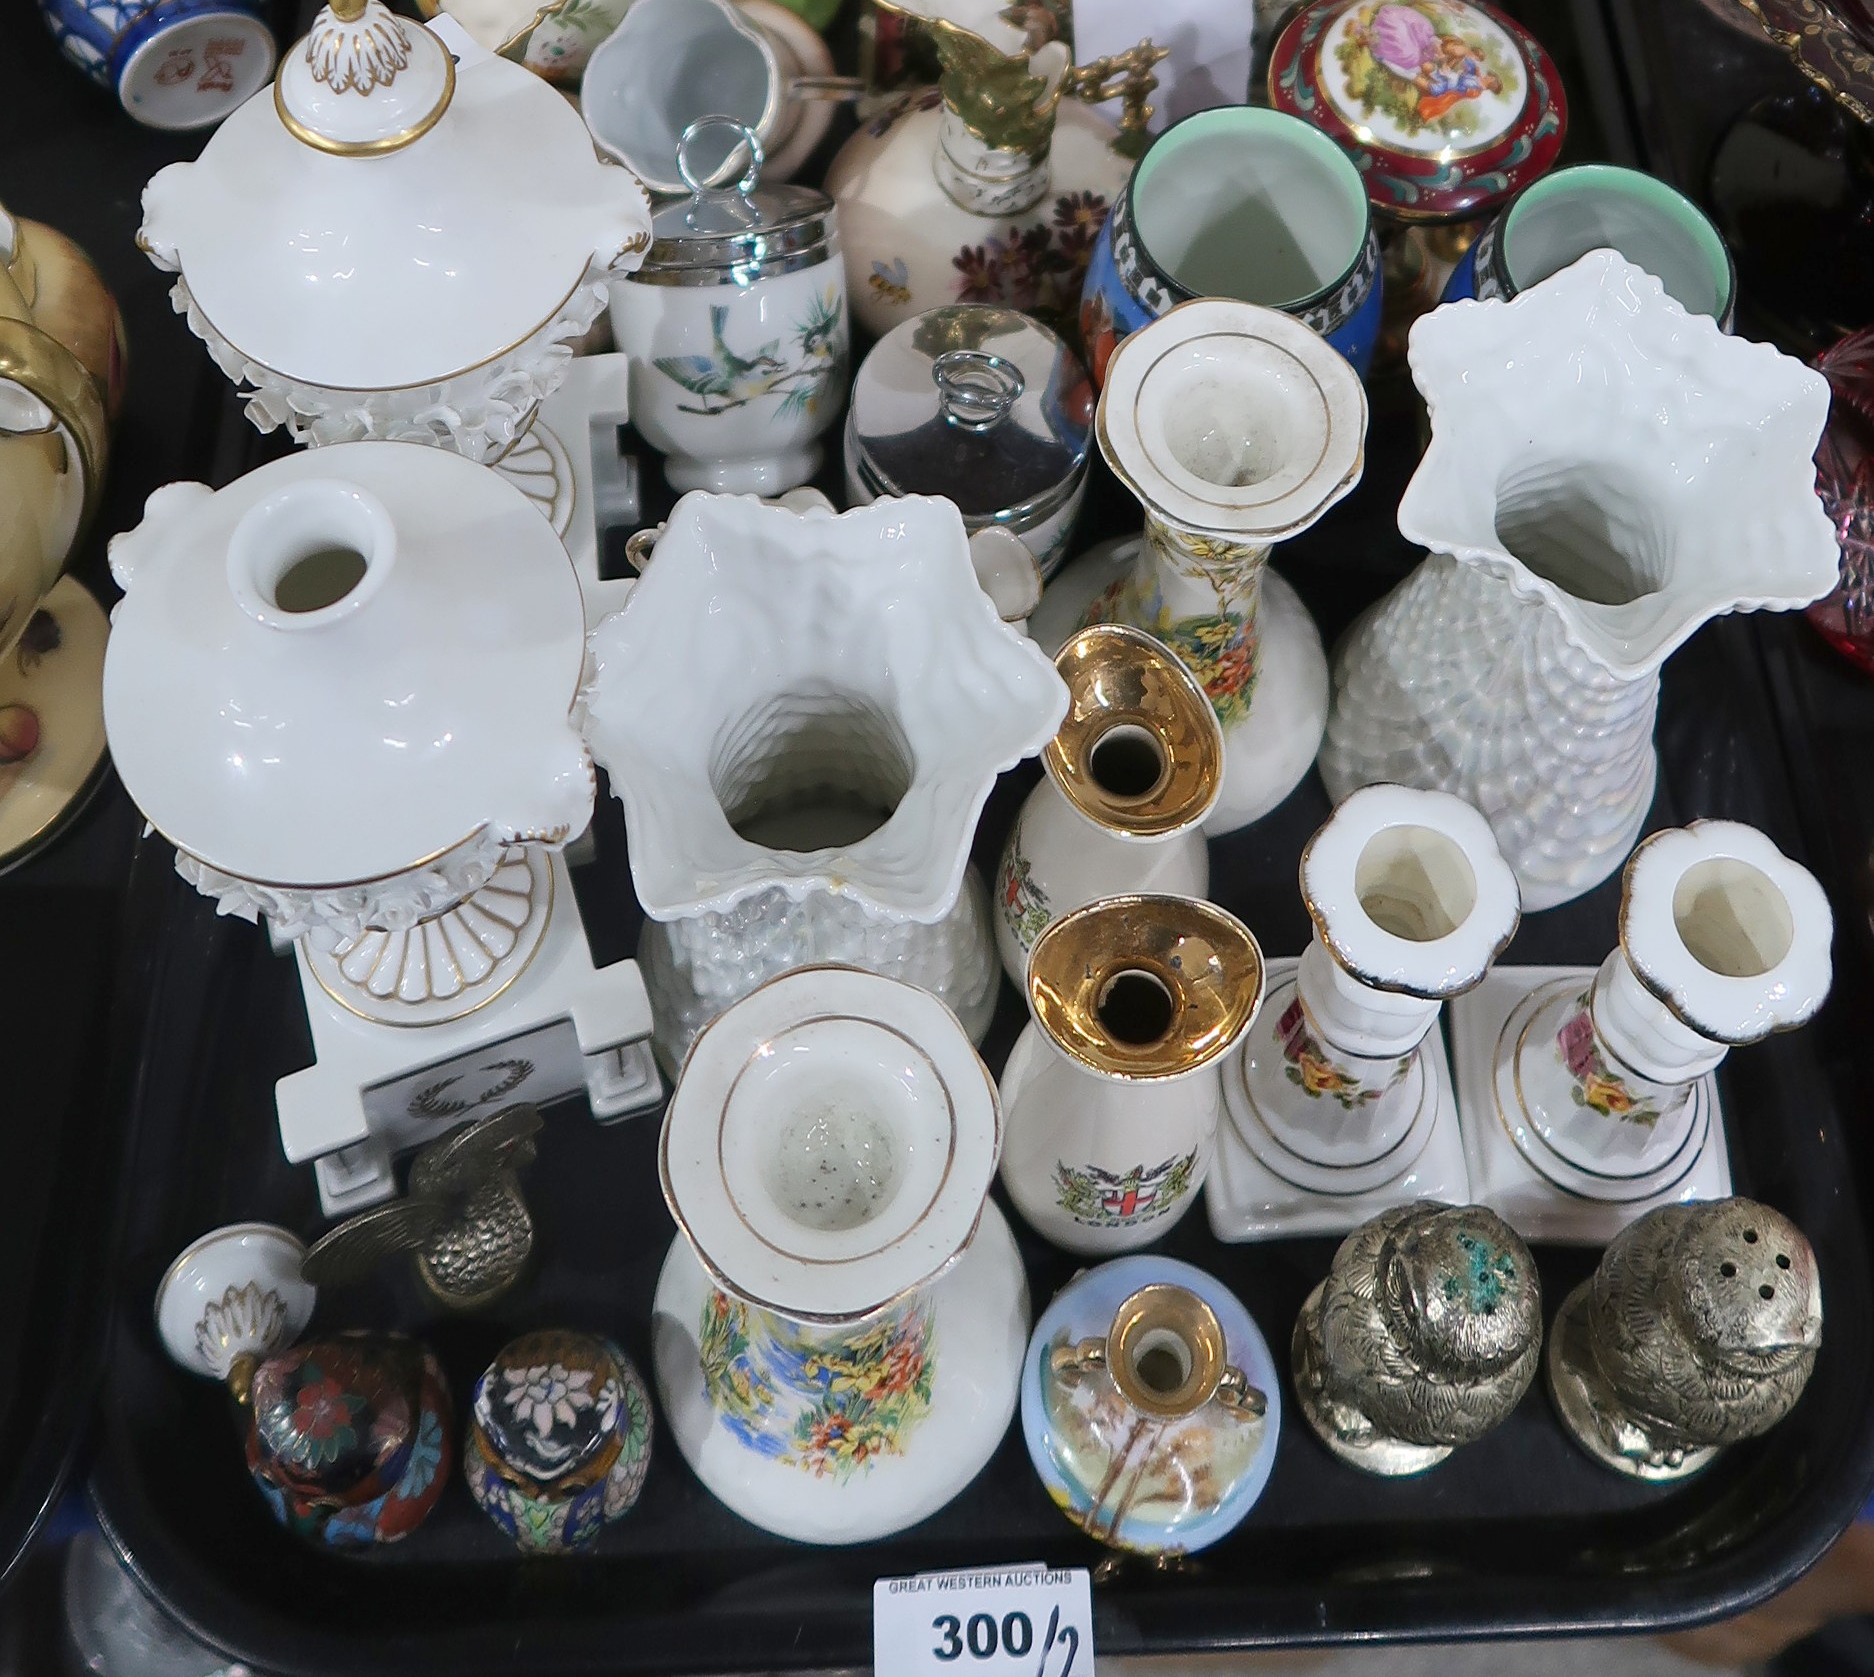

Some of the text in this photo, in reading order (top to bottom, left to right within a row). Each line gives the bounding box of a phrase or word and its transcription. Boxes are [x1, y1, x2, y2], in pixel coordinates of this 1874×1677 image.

[889, 1570, 1072, 1594] GREAT WESTERN AUCTIONS
